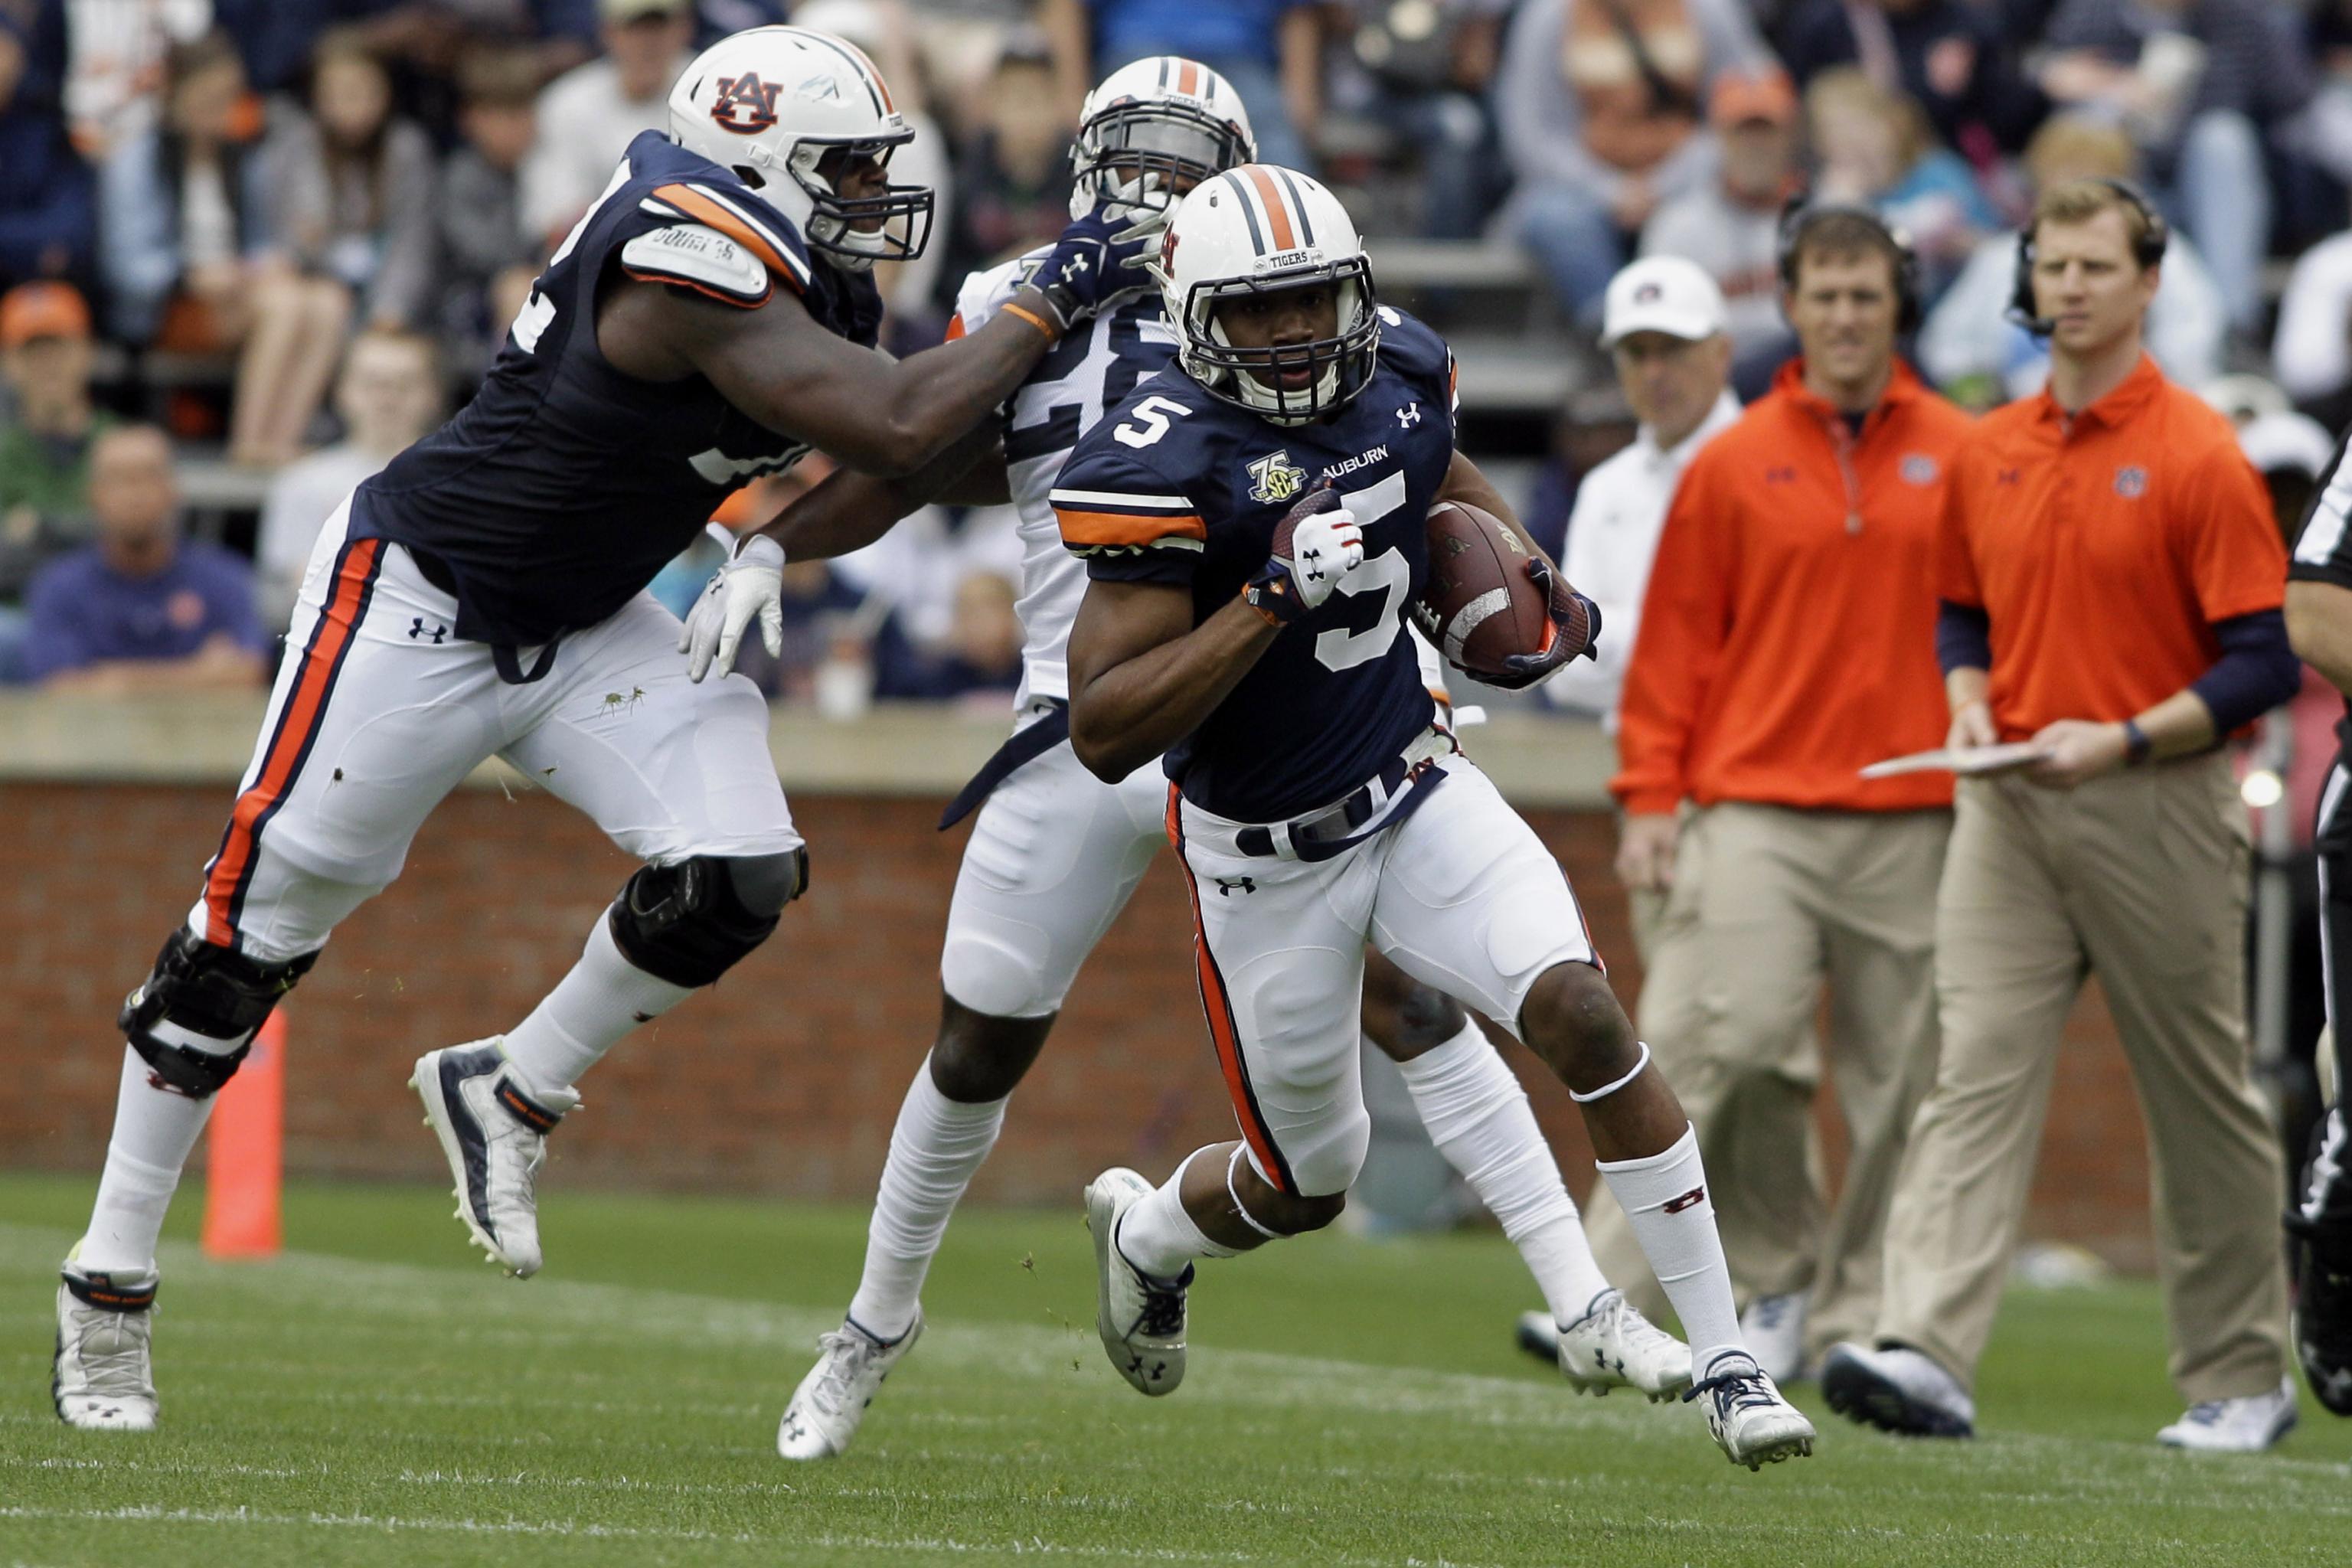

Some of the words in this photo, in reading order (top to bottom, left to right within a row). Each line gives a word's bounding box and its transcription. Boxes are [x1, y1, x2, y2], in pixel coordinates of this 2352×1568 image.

[1269, 251, 1308, 268] TIGERS
[1112, 395, 1194, 449] 5
[1322, 444, 1389, 479] AUBURN
[1266, 470, 1292, 498] SEC
[1314, 469, 1410, 672] 5
